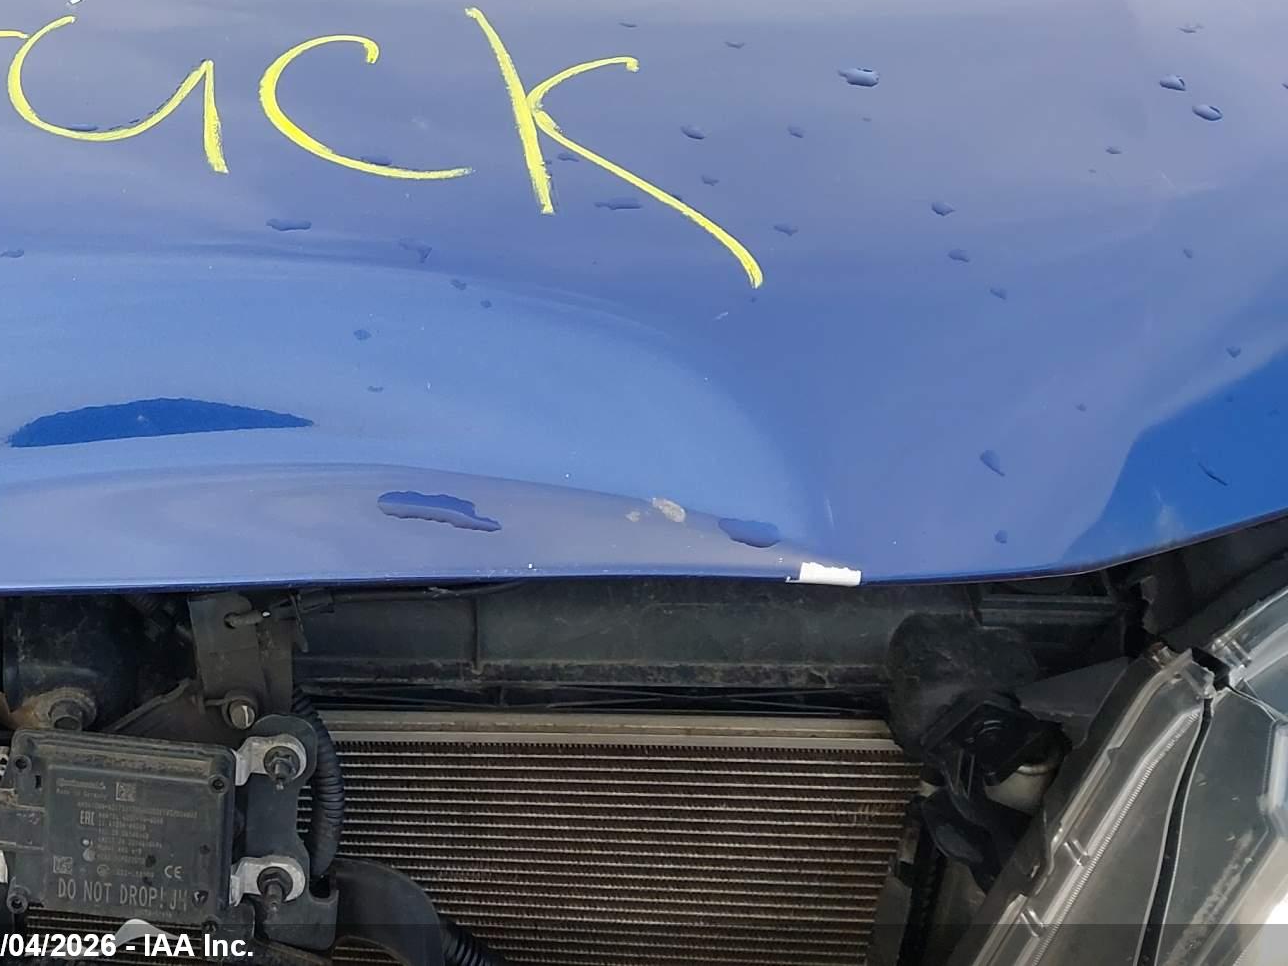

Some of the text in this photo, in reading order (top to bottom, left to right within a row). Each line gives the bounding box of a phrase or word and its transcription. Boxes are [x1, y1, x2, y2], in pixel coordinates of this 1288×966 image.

[57, 878, 76, 900] DO
[83, 880, 112, 902] NOT
[119, 884, 164, 909] DROP!
